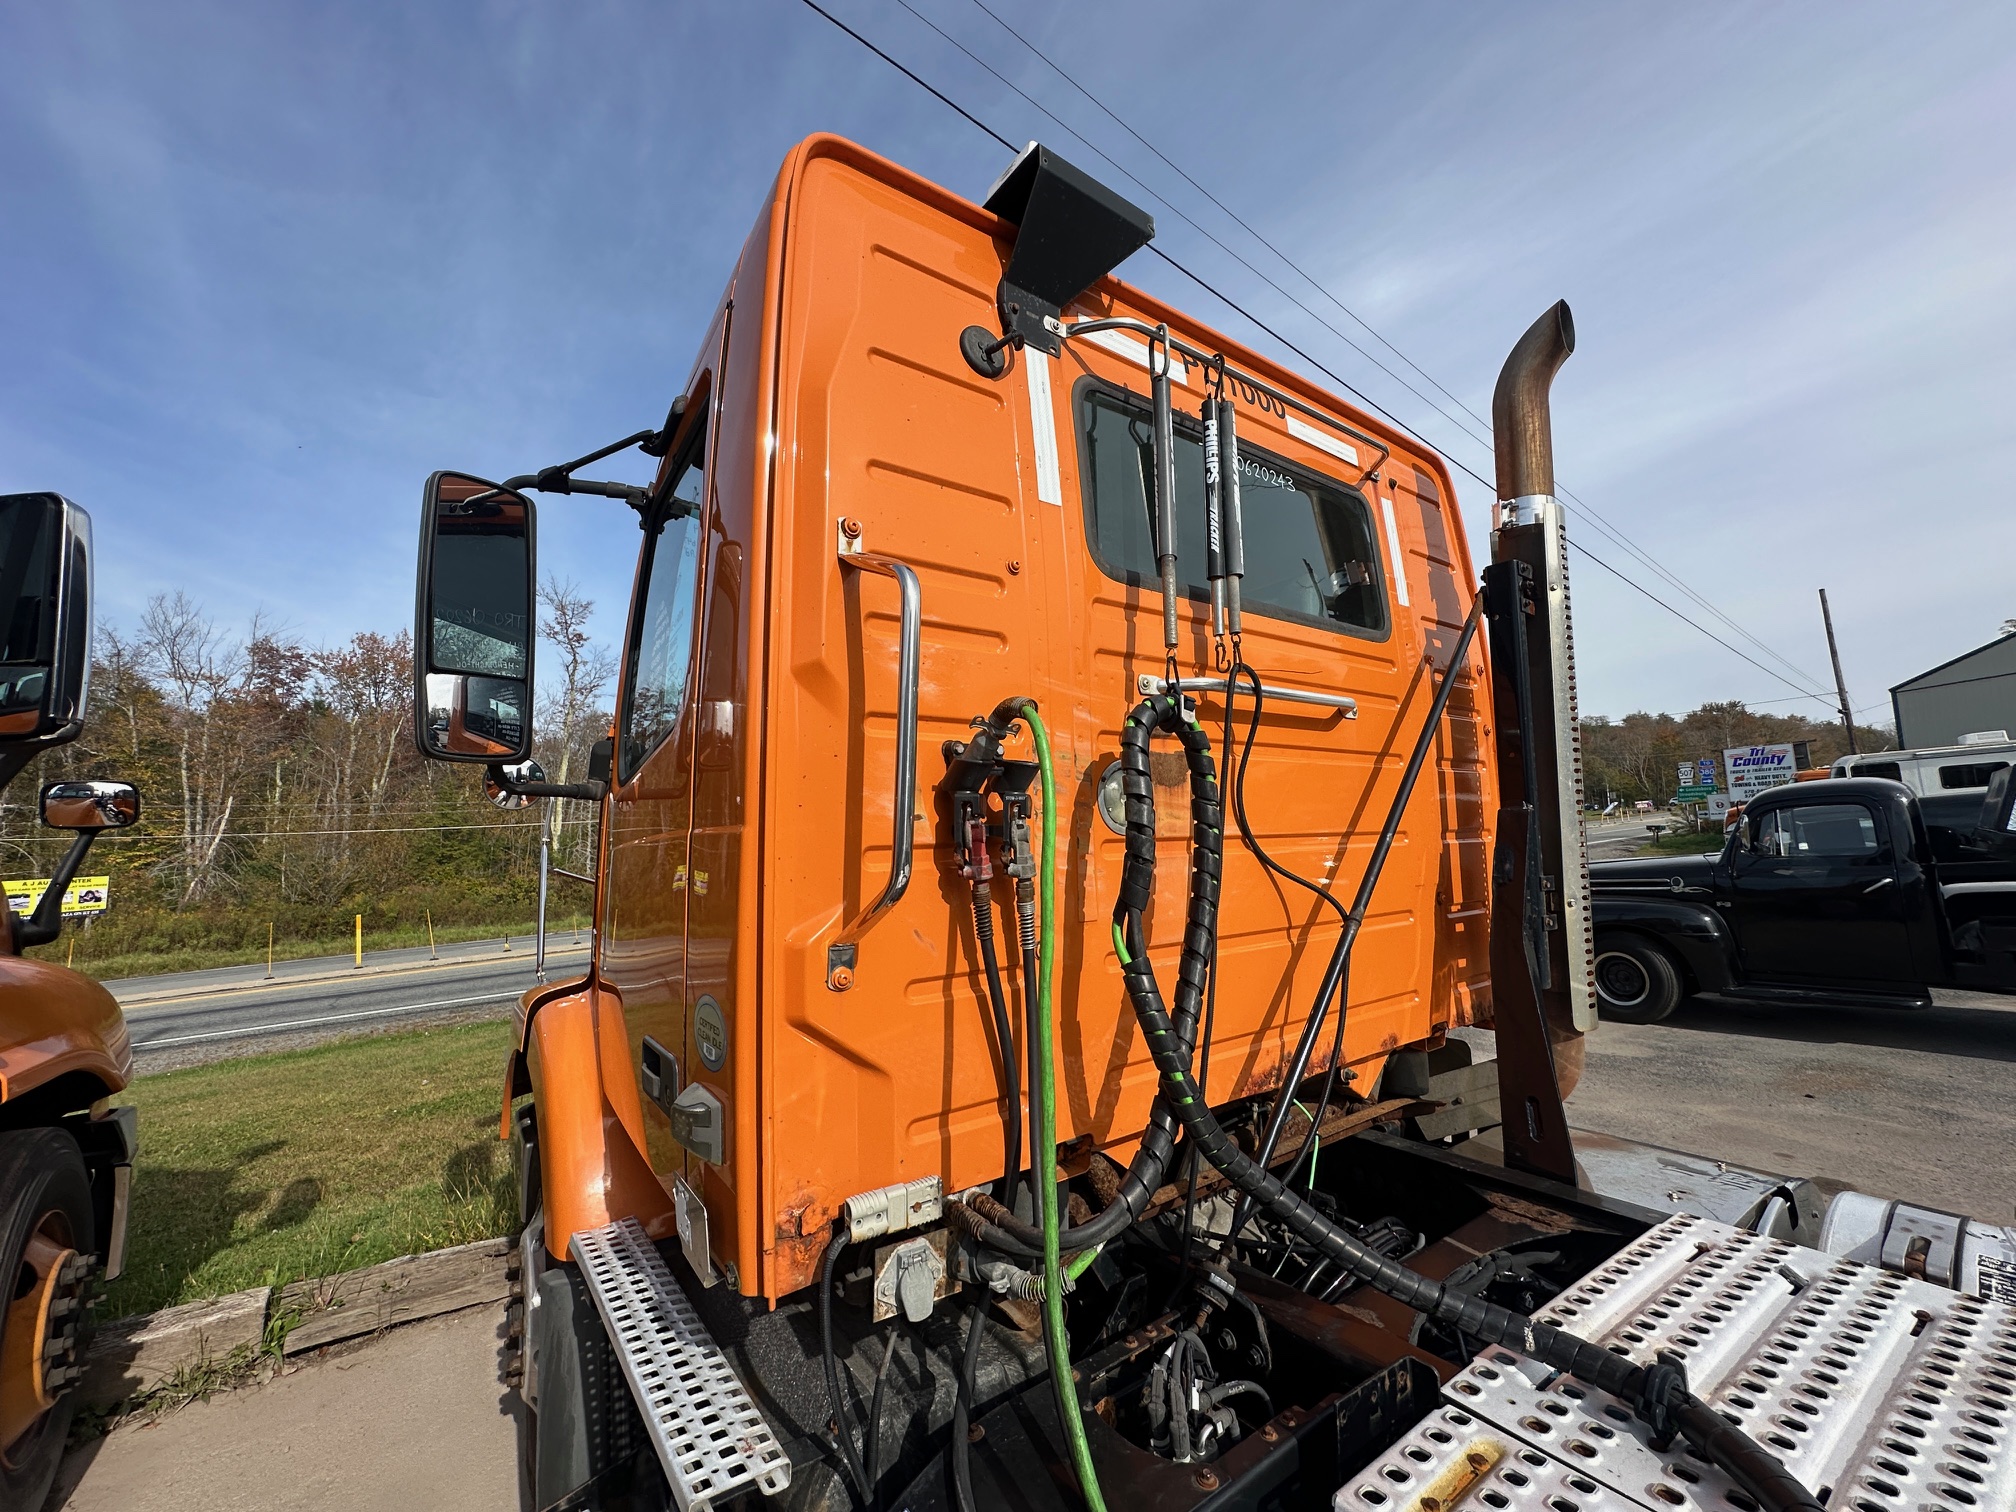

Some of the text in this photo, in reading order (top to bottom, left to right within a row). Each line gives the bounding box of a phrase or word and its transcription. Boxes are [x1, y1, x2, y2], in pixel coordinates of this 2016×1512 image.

[1236, 456, 1296, 492] 0620243
[1204, 420, 1220, 554] PHILLIPS TRACKER
[1732, 754, 1786, 767] County
[1750, 746, 1766, 756] Tri
[700, 1016, 720, 1036] CERTIFIED
[698, 1027, 722, 1050] CLEAN IDLE
